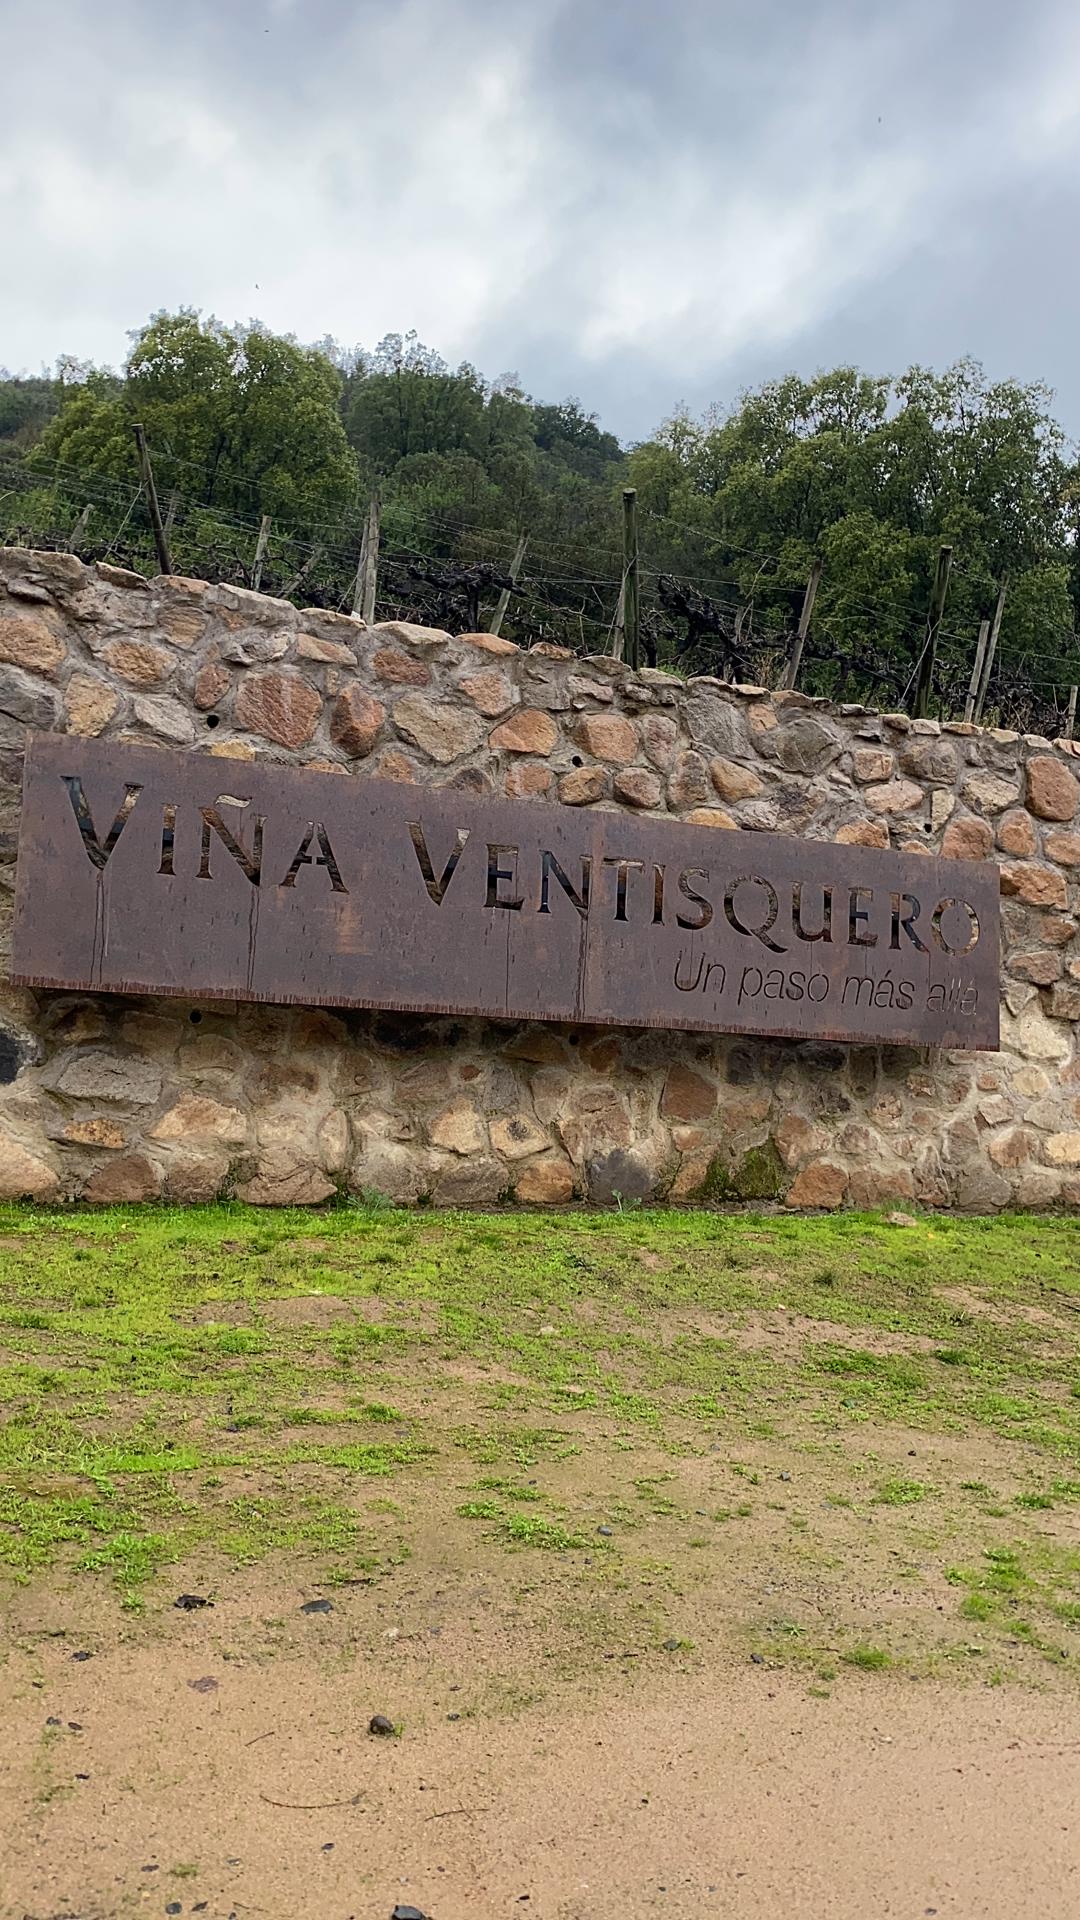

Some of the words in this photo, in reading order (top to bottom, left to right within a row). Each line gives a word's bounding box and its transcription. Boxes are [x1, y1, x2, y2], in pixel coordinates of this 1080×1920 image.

[60, 774, 350, 895] VIÑA
[404, 820, 981, 957] VENTISQUERO
[674, 950, 726, 994] Un
[737, 966, 830, 1006] paso
[841, 969, 915, 1010] más
[925, 975, 979, 1017] allá
